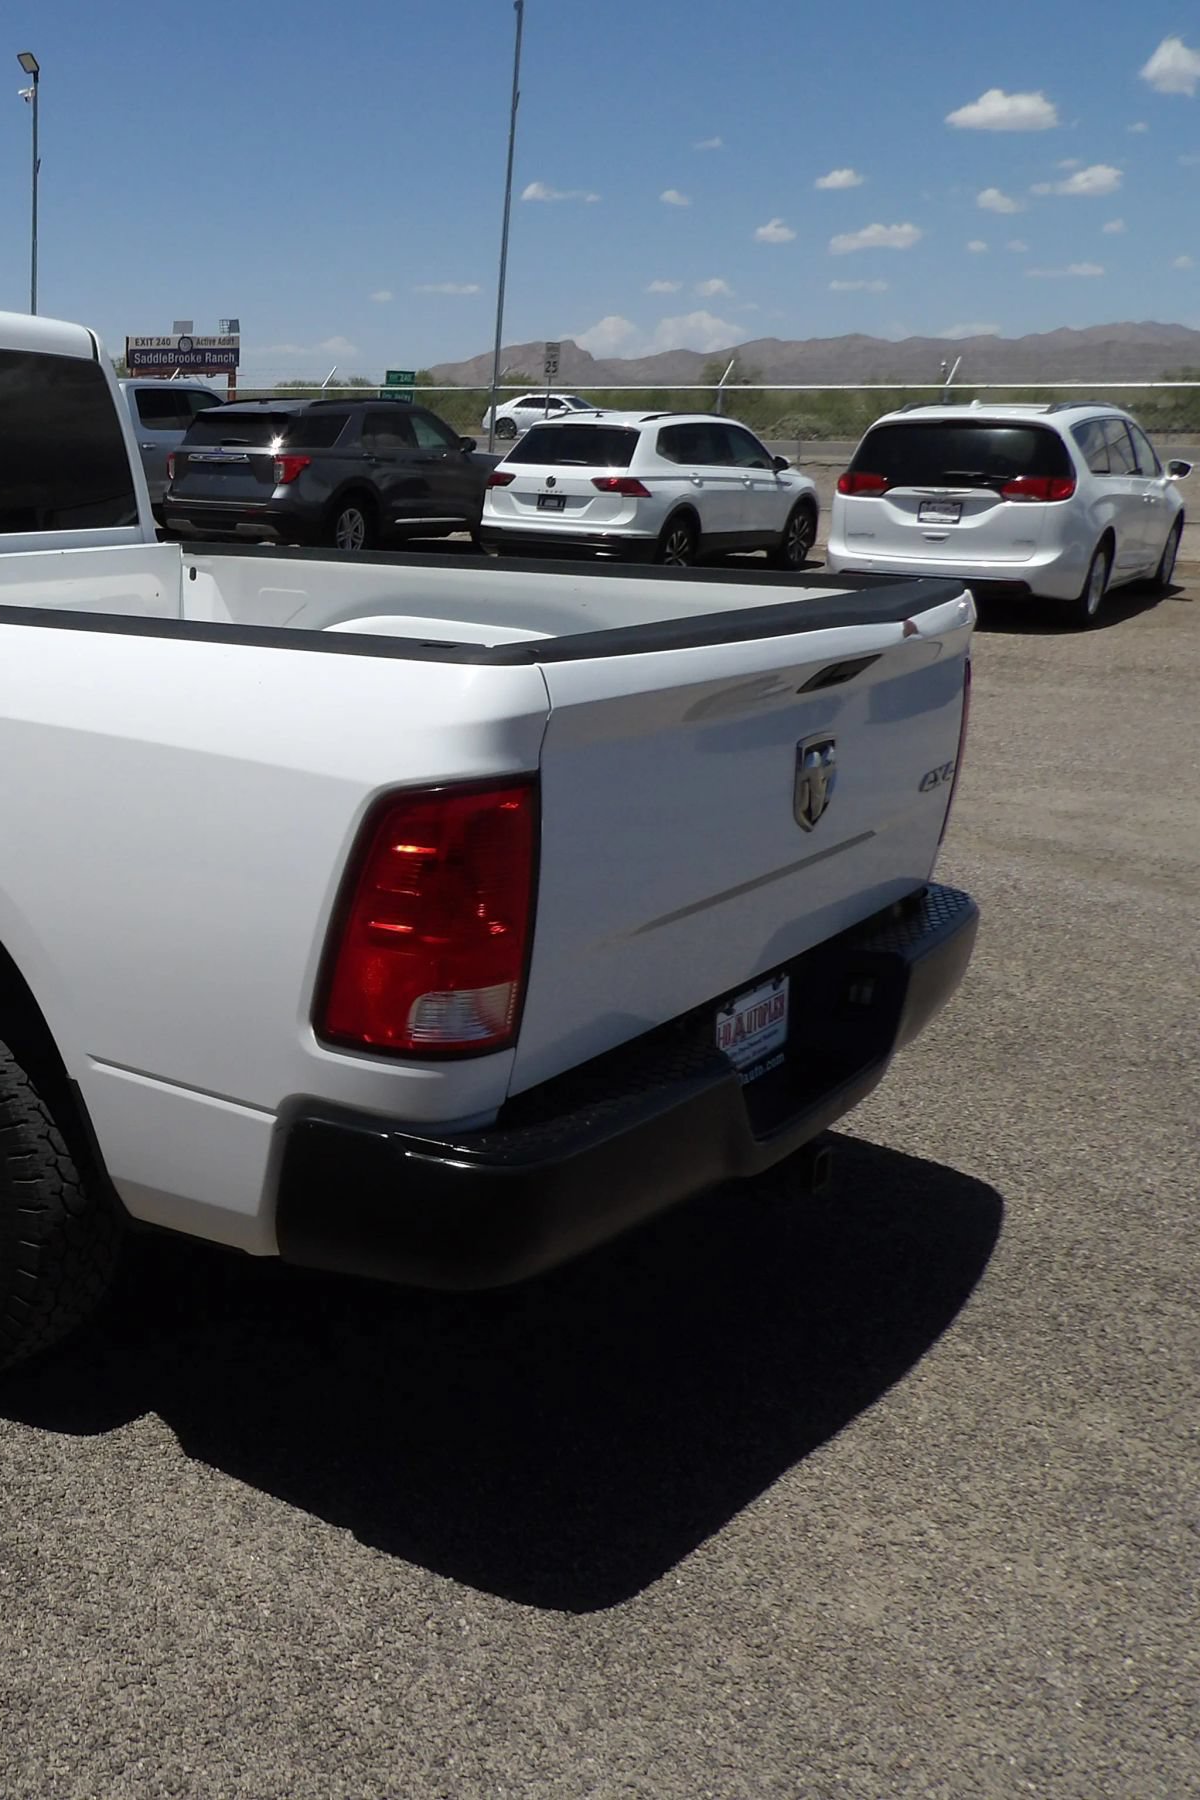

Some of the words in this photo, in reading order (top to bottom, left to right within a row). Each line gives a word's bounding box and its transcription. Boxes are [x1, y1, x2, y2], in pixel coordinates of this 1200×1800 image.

[135, 337, 153, 347] EXIT
[156, 337, 171, 347] 240
[134, 352, 202, 365] SaddleBrooke
[205, 352, 235, 364] Ranch
[544, 360, 559, 374] 25
